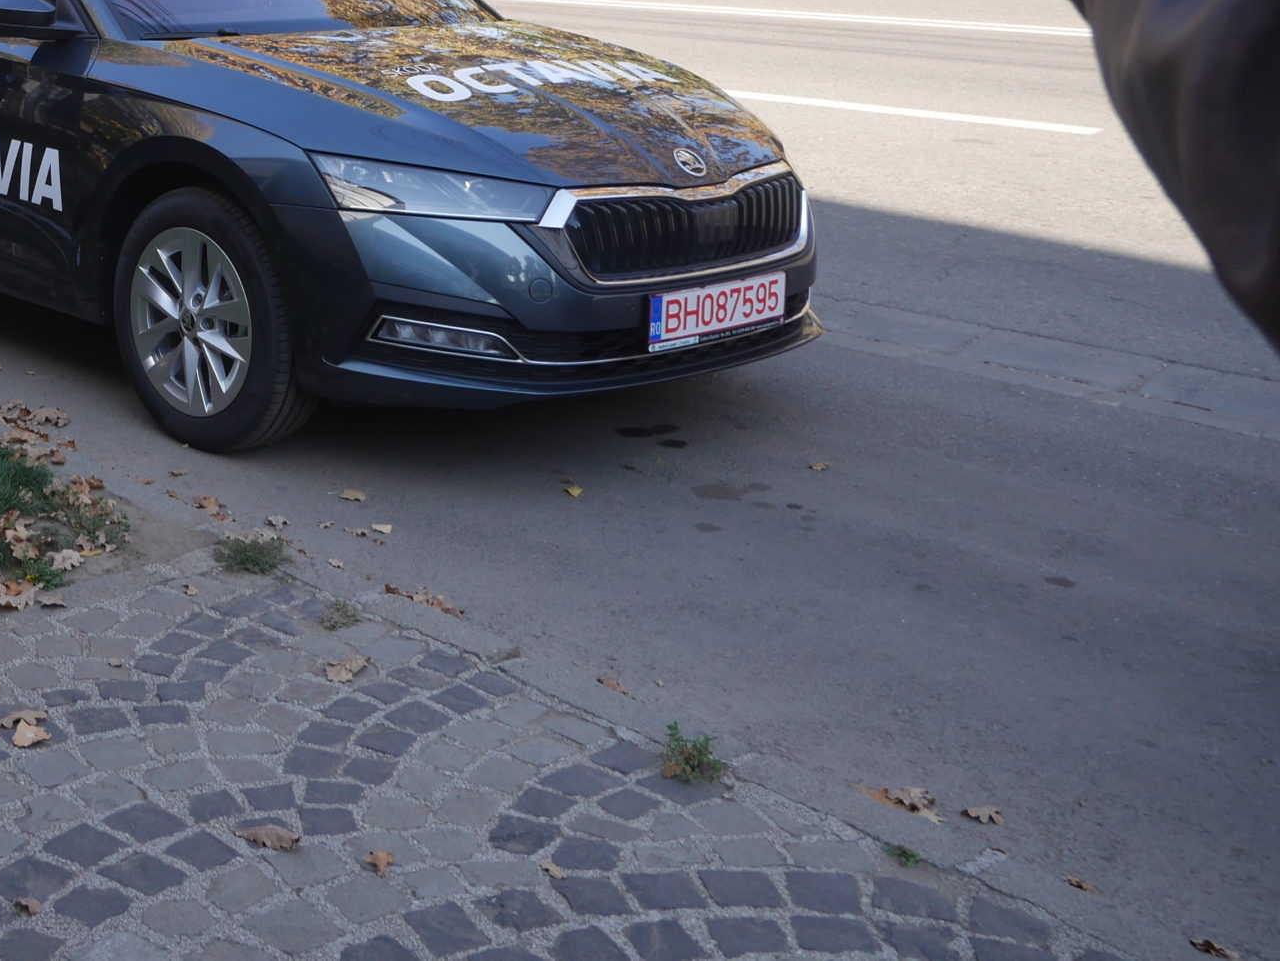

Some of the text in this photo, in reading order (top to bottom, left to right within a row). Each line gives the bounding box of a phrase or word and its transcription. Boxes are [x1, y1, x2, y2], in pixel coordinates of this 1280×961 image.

[407, 59, 680, 102] OCTAVIA
[665, 279, 779, 334] BH087595
[650, 321, 661, 336] RO
